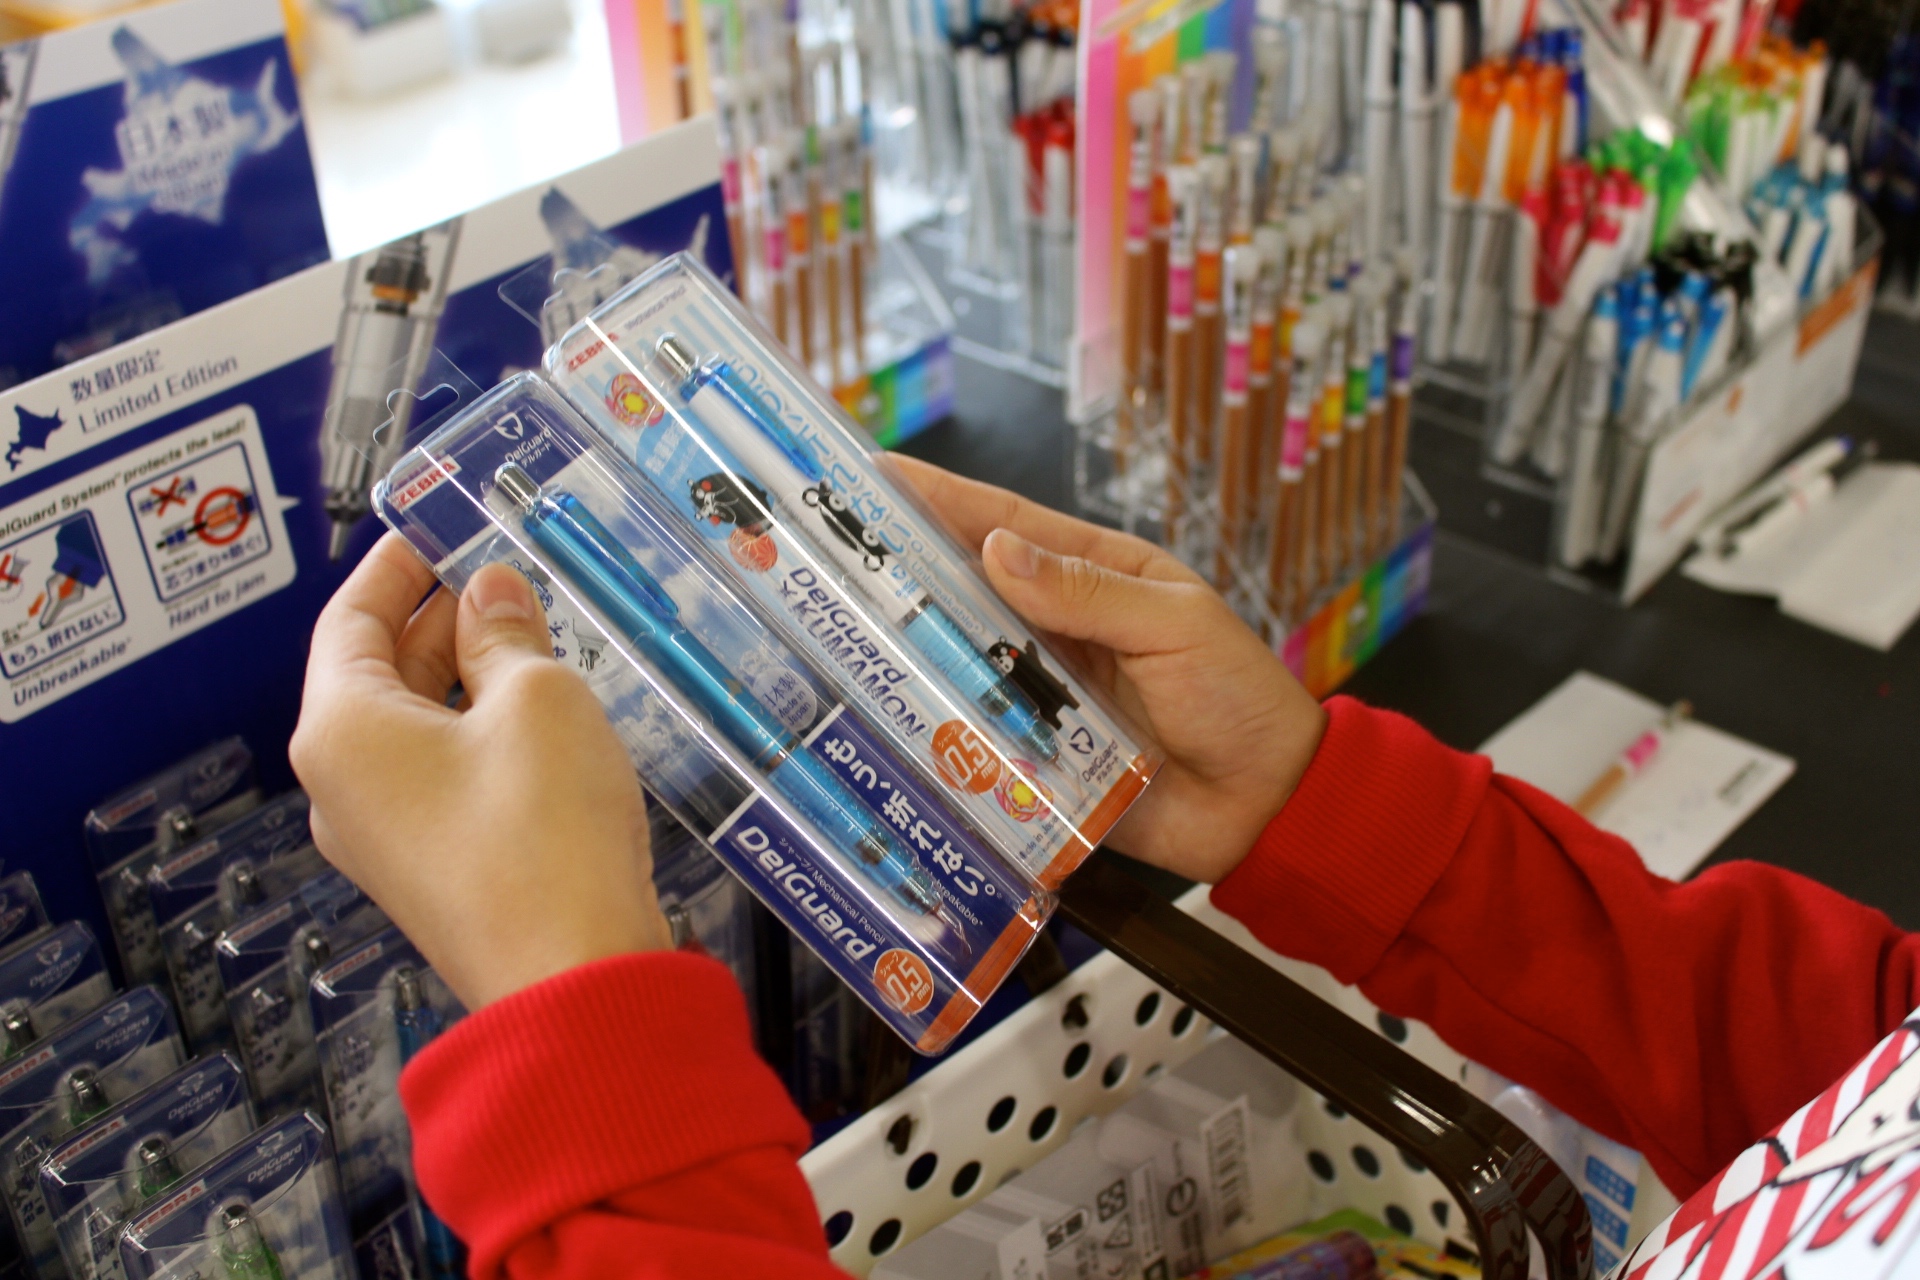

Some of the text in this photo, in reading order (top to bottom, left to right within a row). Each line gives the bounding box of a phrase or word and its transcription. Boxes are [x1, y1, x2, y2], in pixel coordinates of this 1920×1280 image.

[567, 332, 620, 374] ZEBRA
[70, 349, 162, 403] 数量限定
[78, 355, 239, 435] Limited Edition
[505, 425, 552, 464] DelGuard
[398, 460, 456, 511] ZEBRA
[0, 502, 57, 541] elGuard
[169, 596, 210, 631] Hard
[214, 590, 231, 607] to
[789, 566, 909, 684] DelGuard
[788, 701, 812, 727] Japan
[943, 726, 989, 787] 0.5
[981, 758, 998, 780] mm
[1081, 738, 1119, 783] DelGuard
[823, 737, 998, 898] もう、折れない。
[1041, 815, 1060, 836] Japa
[737, 825, 878, 962] DelGuard
[811, 869, 860, 921] Mechanical
[857, 915, 887, 947] Pencil
[885, 956, 925, 1011] 0.5
[916, 983, 931, 1002] mm
[0, 1050, 50, 1086] EBRA
[168, 1083, 223, 1121] DelGuard
[246, 1142, 303, 1184] DelGuard
